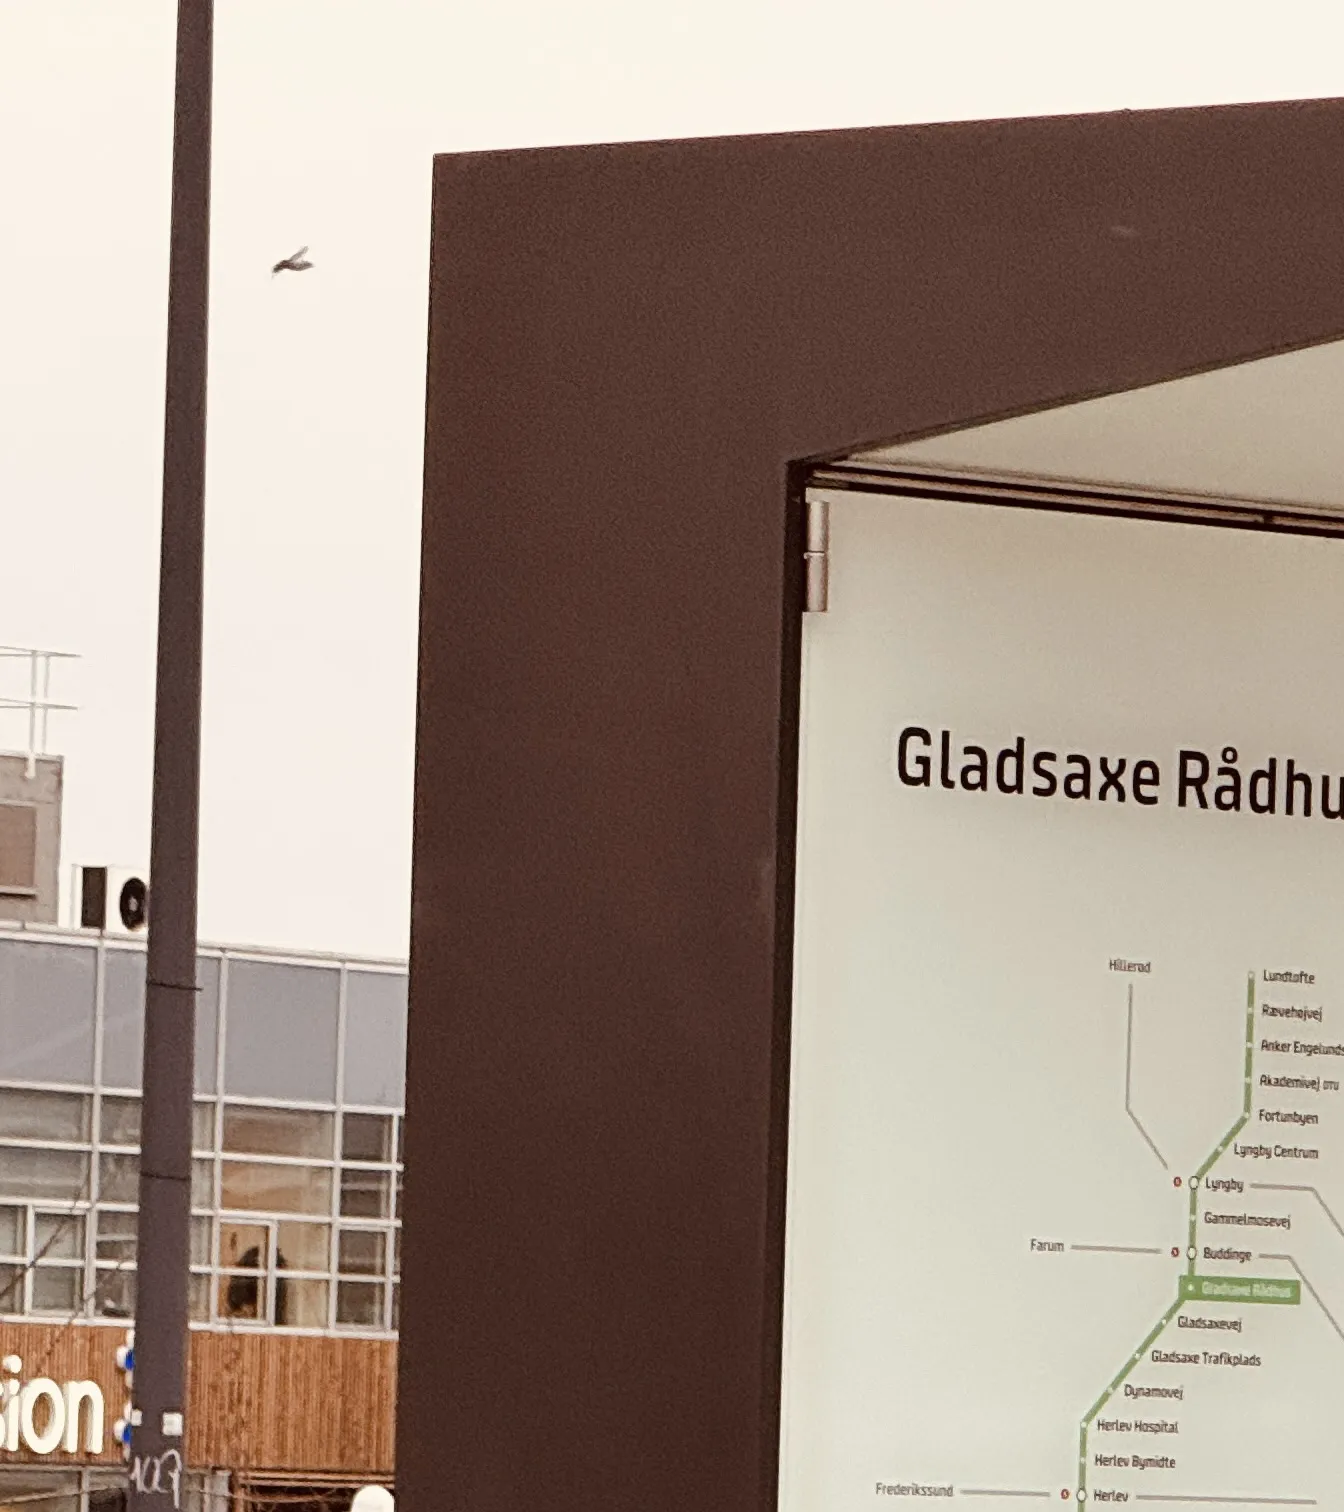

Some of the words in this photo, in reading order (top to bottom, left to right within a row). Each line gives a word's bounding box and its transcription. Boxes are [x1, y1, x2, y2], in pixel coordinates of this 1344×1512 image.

[898, 727, 1160, 805] Gladsaxe
[1261, 1039, 1291, 1052] Anker
[1260, 1074, 1320, 1092] Akademivej
[1259, 1109, 1318, 1126] Fortunbyen
[1234, 1143, 1272, 1159] Lyngby
[1274, 1145, 1318, 1159] Centrum
[1206, 1177, 1244, 1193] Lyngby
[1031, 1238, 1064, 1252] Farum
[1204, 1247, 1251, 1263] Buddinge
[1178, 1316, 1242, 1333] Gladsaxevej
[1152, 1350, 1200, 1364] Gladsaxe
[1203, 1352, 1261, 1366] Trafikplads
[1124, 1384, 1183, 1400] Dynamovej
[0, 1354, 105, 1455] ion
[1097, 1419, 1132, 1432] Herlev
[1134, 1420, 1178, 1434] Hospital
[1095, 1454, 1129, 1467] Herlev
[1132, 1455, 1175, 1470] Bymidte
[876, 1482, 953, 1497] Frederikssund
[1094, 1489, 1128, 1502] Herlev
